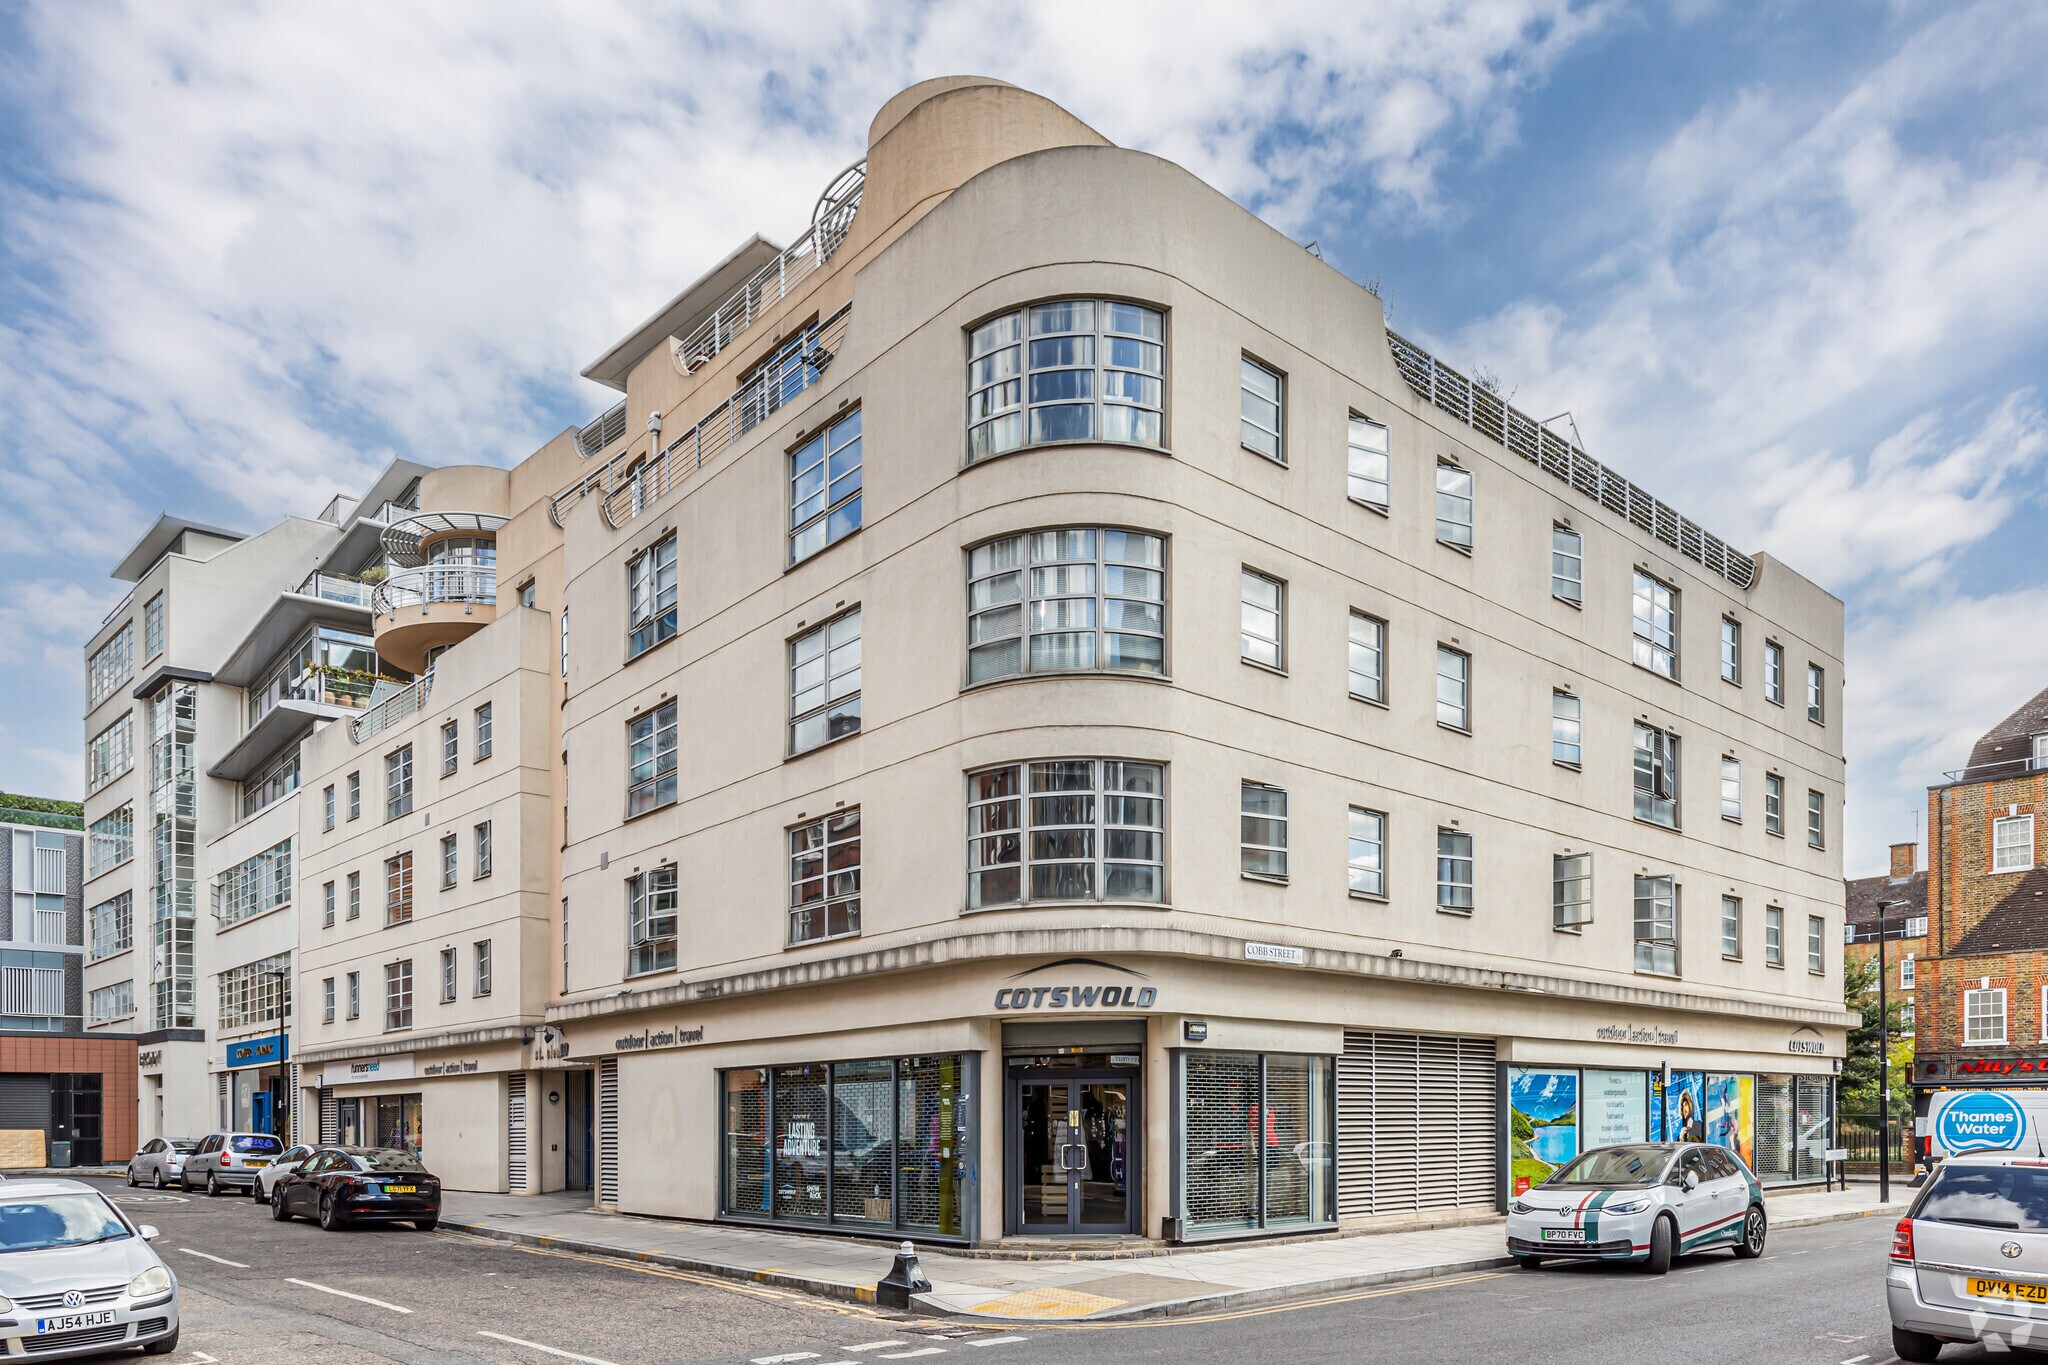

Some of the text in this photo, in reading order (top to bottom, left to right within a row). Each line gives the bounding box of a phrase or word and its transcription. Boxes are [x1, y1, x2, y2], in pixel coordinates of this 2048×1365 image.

[1247, 945, 1268, 956] COBB
[1269, 948, 1296, 959] STREET
[994, 986, 1158, 1010] COTSWOLD
[615, 1026, 703, 1050] outdoor action travel
[1596, 1025, 1678, 1044] outdoor action travel
[1789, 1040, 1824, 1054] COTSWOLD
[351, 1058, 380, 1073] runnersneed
[424, 1060, 478, 1076] outdoor action travel
[1958, 1059, 2034, 1074] Nilly's
[1604, 1089, 1627, 1097] waterproofs
[1949, 1111, 2013, 1122] Thames
[788, 1122, 815, 1139] LASTING
[1956, 1123, 2006, 1134] Water
[783, 1139, 820, 1156] ADVENTURE
[1611, 1136, 1631, 1144] equipment
[1546, 1229, 1585, 1239] BP70 FVC
[1976, 1280, 2047, 1299] OV14 EZD
[47, 1312, 111, 1332] AJ54 HJE
